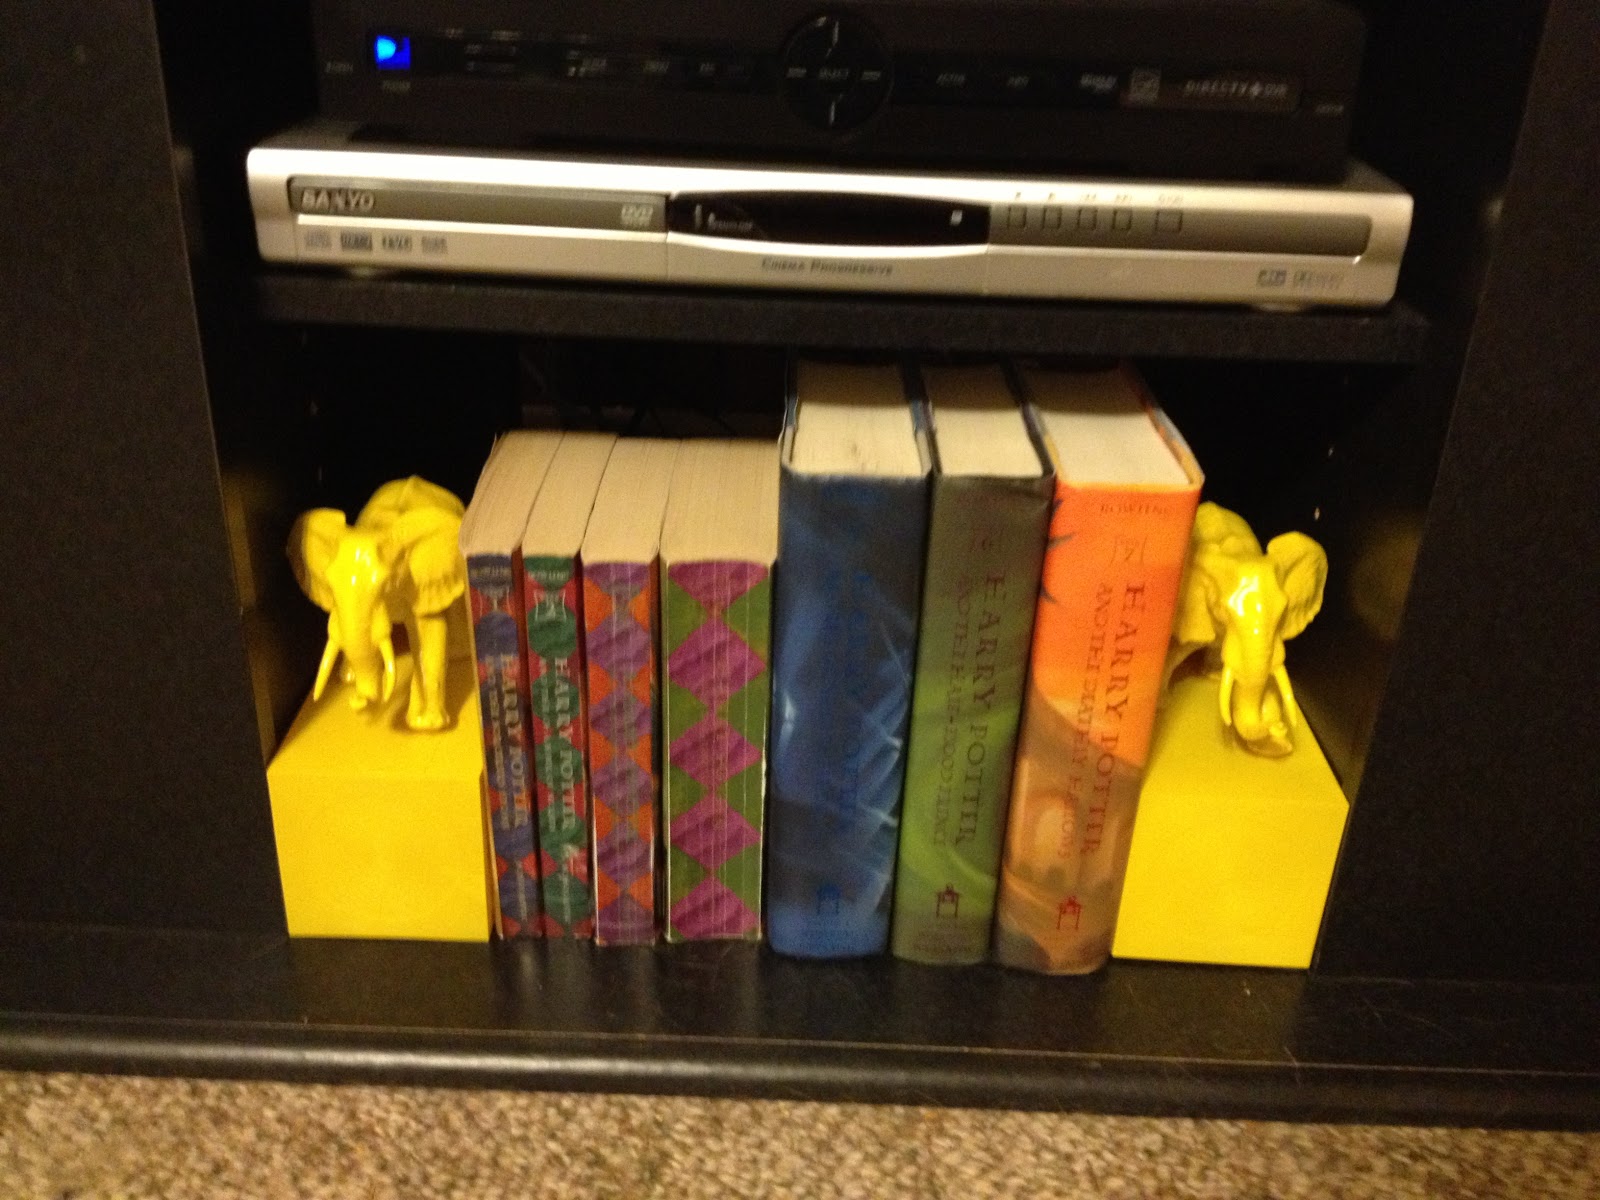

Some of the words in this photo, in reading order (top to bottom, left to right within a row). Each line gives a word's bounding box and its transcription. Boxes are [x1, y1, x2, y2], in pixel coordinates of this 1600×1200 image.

[301, 187, 375, 211] SANYO
[554, 656, 572, 741] HARRY
[972, 572, 1007, 709] HARRY
[1104, 583, 1147, 721] HARRY
[559, 749, 575, 831] POTTER
[955, 724, 989, 848] POTTER
[1080, 733, 1119, 858] POTTER
